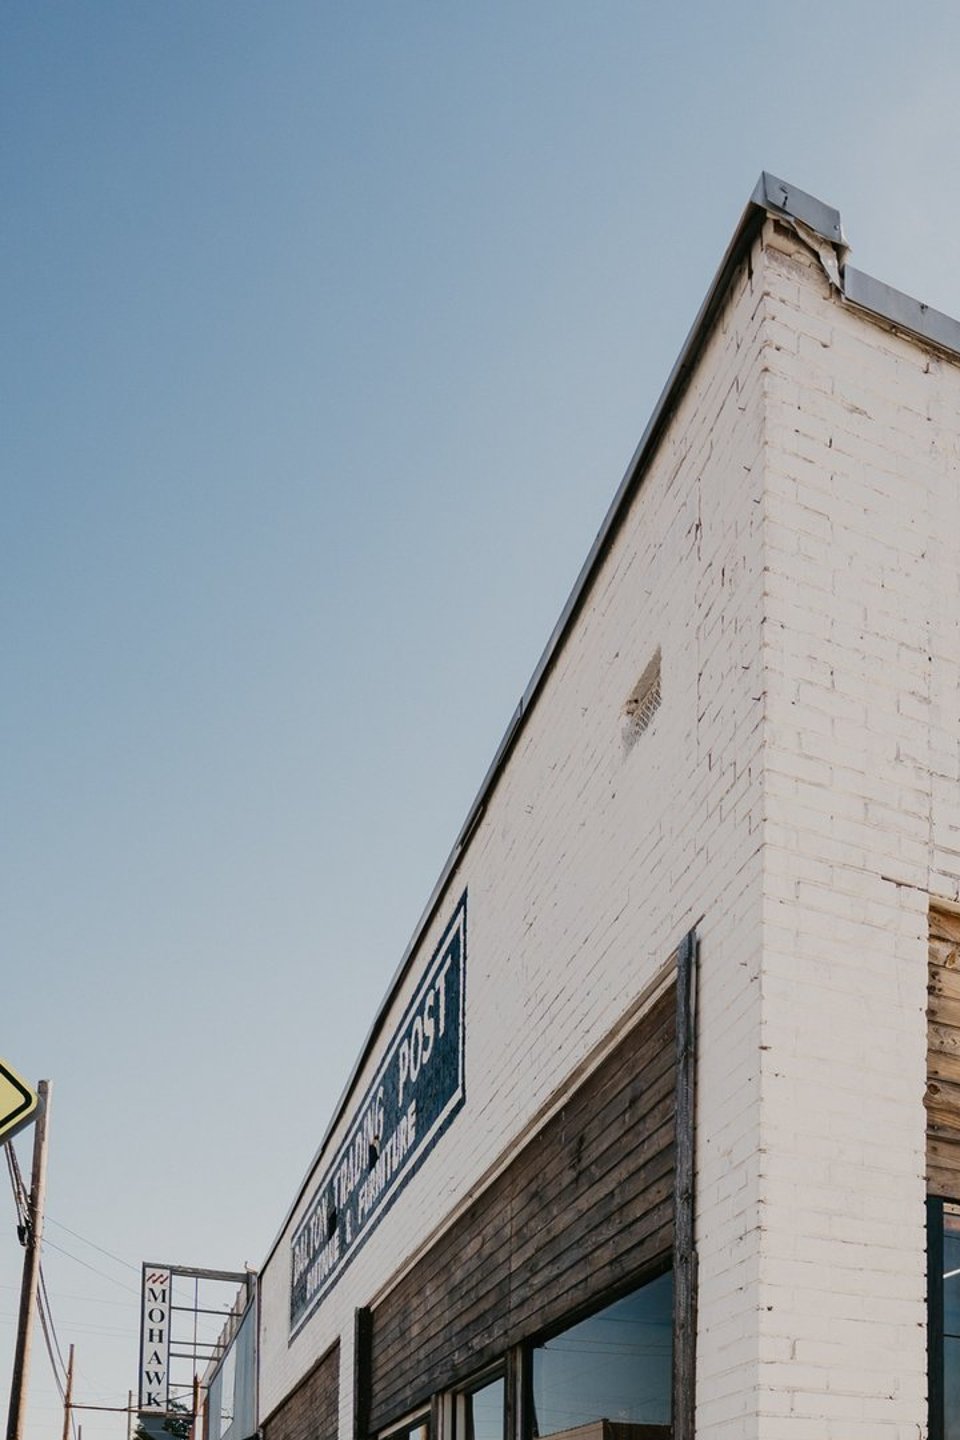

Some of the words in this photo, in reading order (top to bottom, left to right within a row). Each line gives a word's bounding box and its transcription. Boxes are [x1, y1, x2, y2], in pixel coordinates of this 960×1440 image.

[294, 1190, 329, 1286] DALTON
[333, 1086, 384, 1211] TRADING
[399, 953, 452, 1107] POST
[358, 1098, 416, 1225] FURNITURE
[145, 1287, 167, 1407] MOHAWK
